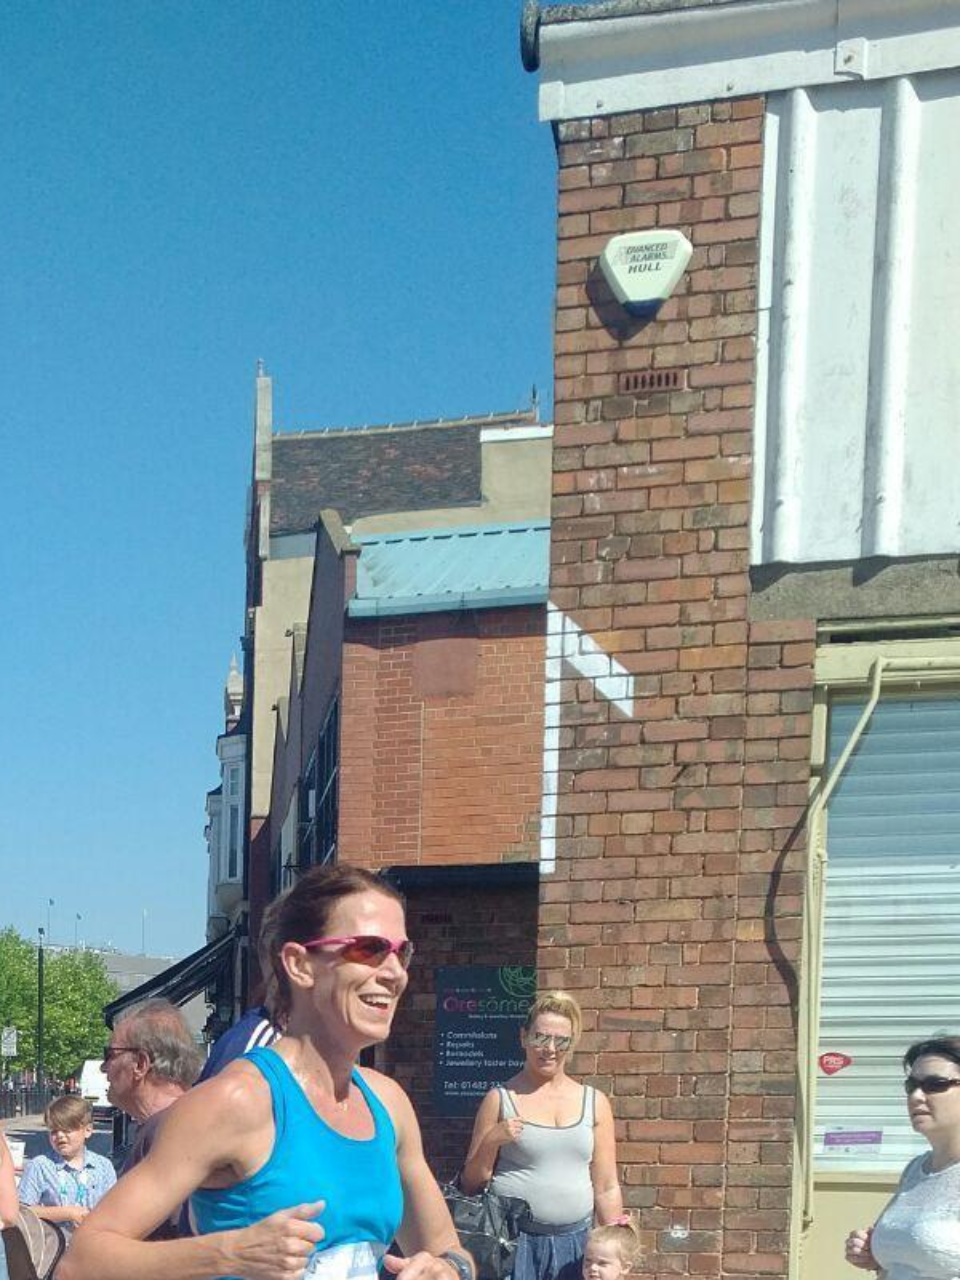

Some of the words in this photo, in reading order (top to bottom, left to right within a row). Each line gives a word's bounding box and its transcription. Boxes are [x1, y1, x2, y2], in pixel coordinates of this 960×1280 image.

[629, 252, 667, 262] ALARMS
[628, 262, 662, 274] HULL
[446, 1041, 475, 1049] Repairs
[445, 1059, 482, 1068] Jewellery
